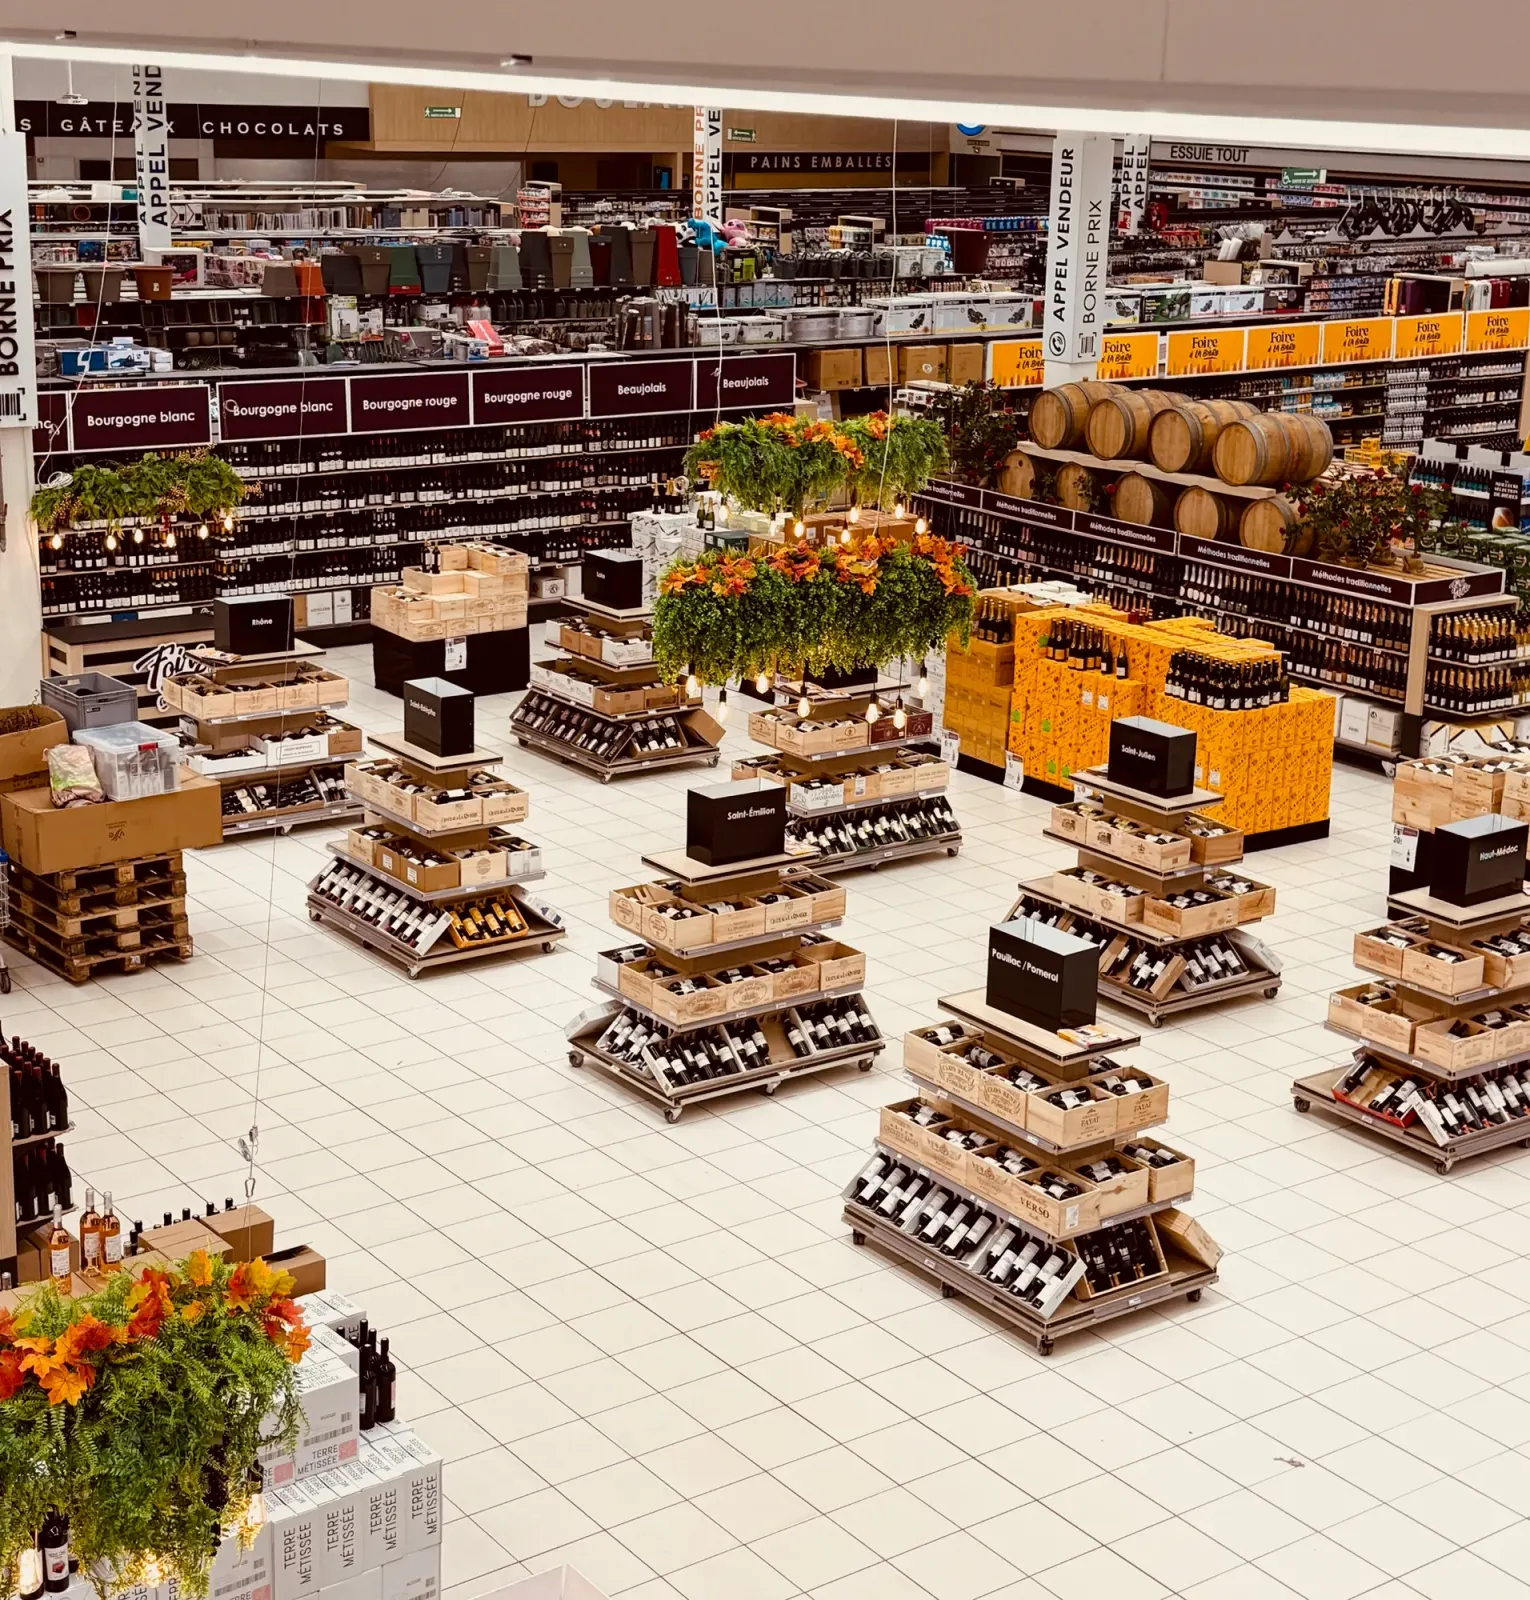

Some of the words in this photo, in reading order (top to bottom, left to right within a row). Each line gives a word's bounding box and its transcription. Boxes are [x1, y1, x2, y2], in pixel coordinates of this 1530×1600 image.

[202, 121, 344, 136] CHOCOLATS
[751, 156, 801, 169] PAINS
[811, 152, 892, 169] EMBALLÉS
[1170, 145, 1214, 161] ESSUIE
[1216, 148, 1249, 163] TOUT
[149, 144, 168, 227] APPEL
[695, 144, 704, 221] BORNE
[706, 148, 720, 220] APPEL
[1120, 145, 1135, 209] APPEL
[1133, 145, 1148, 210] APPEL
[1056, 148, 1074, 250] VENDEUR
[1087, 200, 1102, 244] PRIX
[1053, 258, 1068, 322] APPEL
[1082, 251, 1099, 323] BORNE
[0, 280, 19, 376] BORNE
[1345, 326, 1369, 337] Foire
[1417, 322, 1440, 333] Foire
[1487, 316, 1508, 327] Foire
[1104, 342, 1131, 353] Foire
[1192, 337, 1218, 349] Foire
[1270, 332, 1295, 343] Foire
[618, 382, 667, 396] Beaujolais
[723, 376, 769, 391] Beaujolais
[363, 397, 423, 411] Bourgogne
[425, 397, 458, 409] rouge
[484, 390, 540, 404] Bourgogne
[541, 388, 573, 402] rouge
[87, 413, 157, 428] Bourgogne
[160, 410, 196, 423] blanc
[233, 403, 297, 417] Bourgogne
[300, 400, 334, 412] blanc
[1090, 521, 1116, 534] Méthodes
[1117, 527, 1156, 543] traditionnelles
[1198, 544, 1226, 559] Méthodes
[1227, 552, 1271, 569] traditionnelles
[1312, 569, 1345, 584] Méthodes
[1346, 576, 1392, 594] traditionnelles
[252, 618, 273, 626] Rhône
[1121, 744, 1156, 762] Saint-Julien
[727, 806, 775, 820] Saint-Émilion
[1479, 844, 1518, 861] Haut-Médoc
[991, 948, 1021, 970] Pauillac
[1020, 1196, 1050, 1219] VERSO
[312, 1443, 338, 1460] TERRE
[297, 1454, 338, 1475] MÉTISSÉE
[411, 1478, 423, 1520] TERRE
[427, 1474, 438, 1535] MÉTISSÉE
[370, 1493, 382, 1536] TERRE
[386, 1488, 397, 1551] MÉTISSÉE
[327, 1510, 339, 1552] TERRE
[343, 1504, 354, 1568] MÉTISSÉE
[284, 1527, 296, 1569] TERRE
[299, 1521, 311, 1585] MÉTISSÉE
